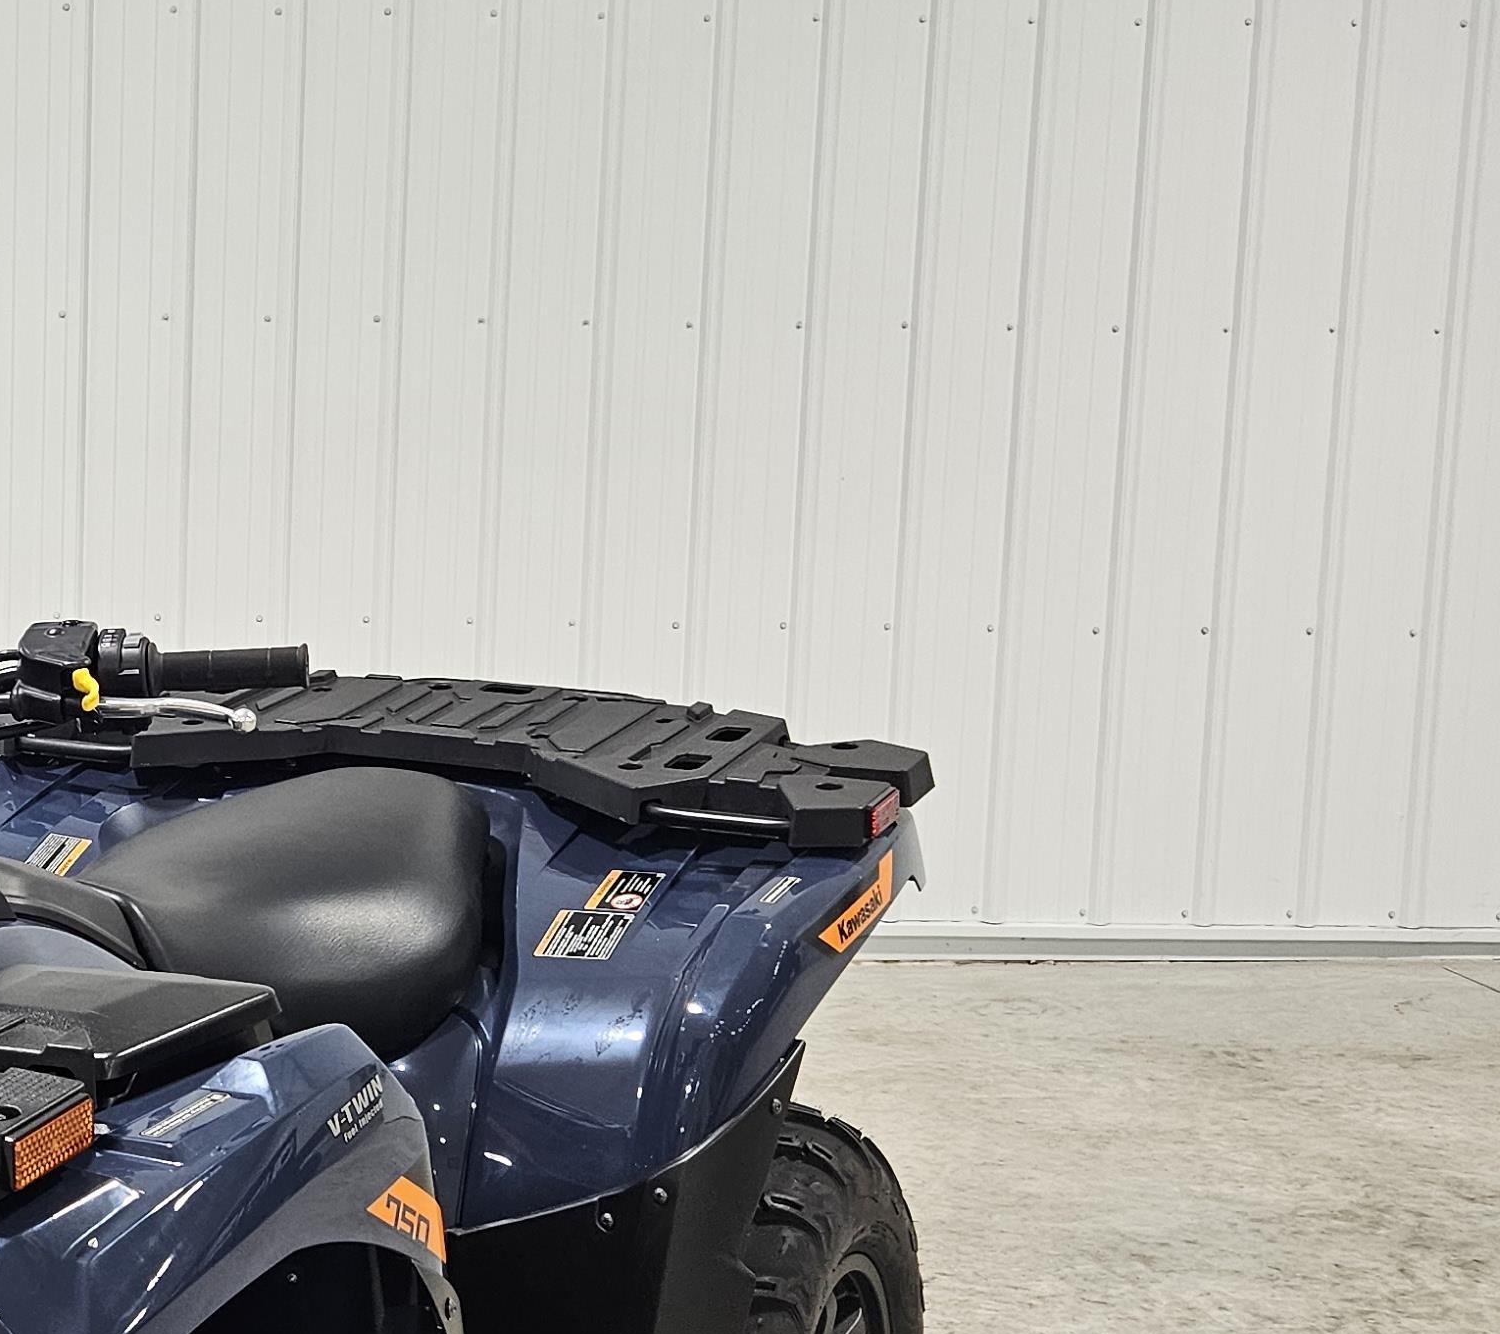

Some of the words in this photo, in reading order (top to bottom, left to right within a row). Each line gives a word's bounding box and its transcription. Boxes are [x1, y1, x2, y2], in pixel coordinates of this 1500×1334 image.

[836, 884, 884, 945] Kawasaki
[326, 1073, 384, 1139] V-TWIN
[385, 1192, 430, 1249] 750
